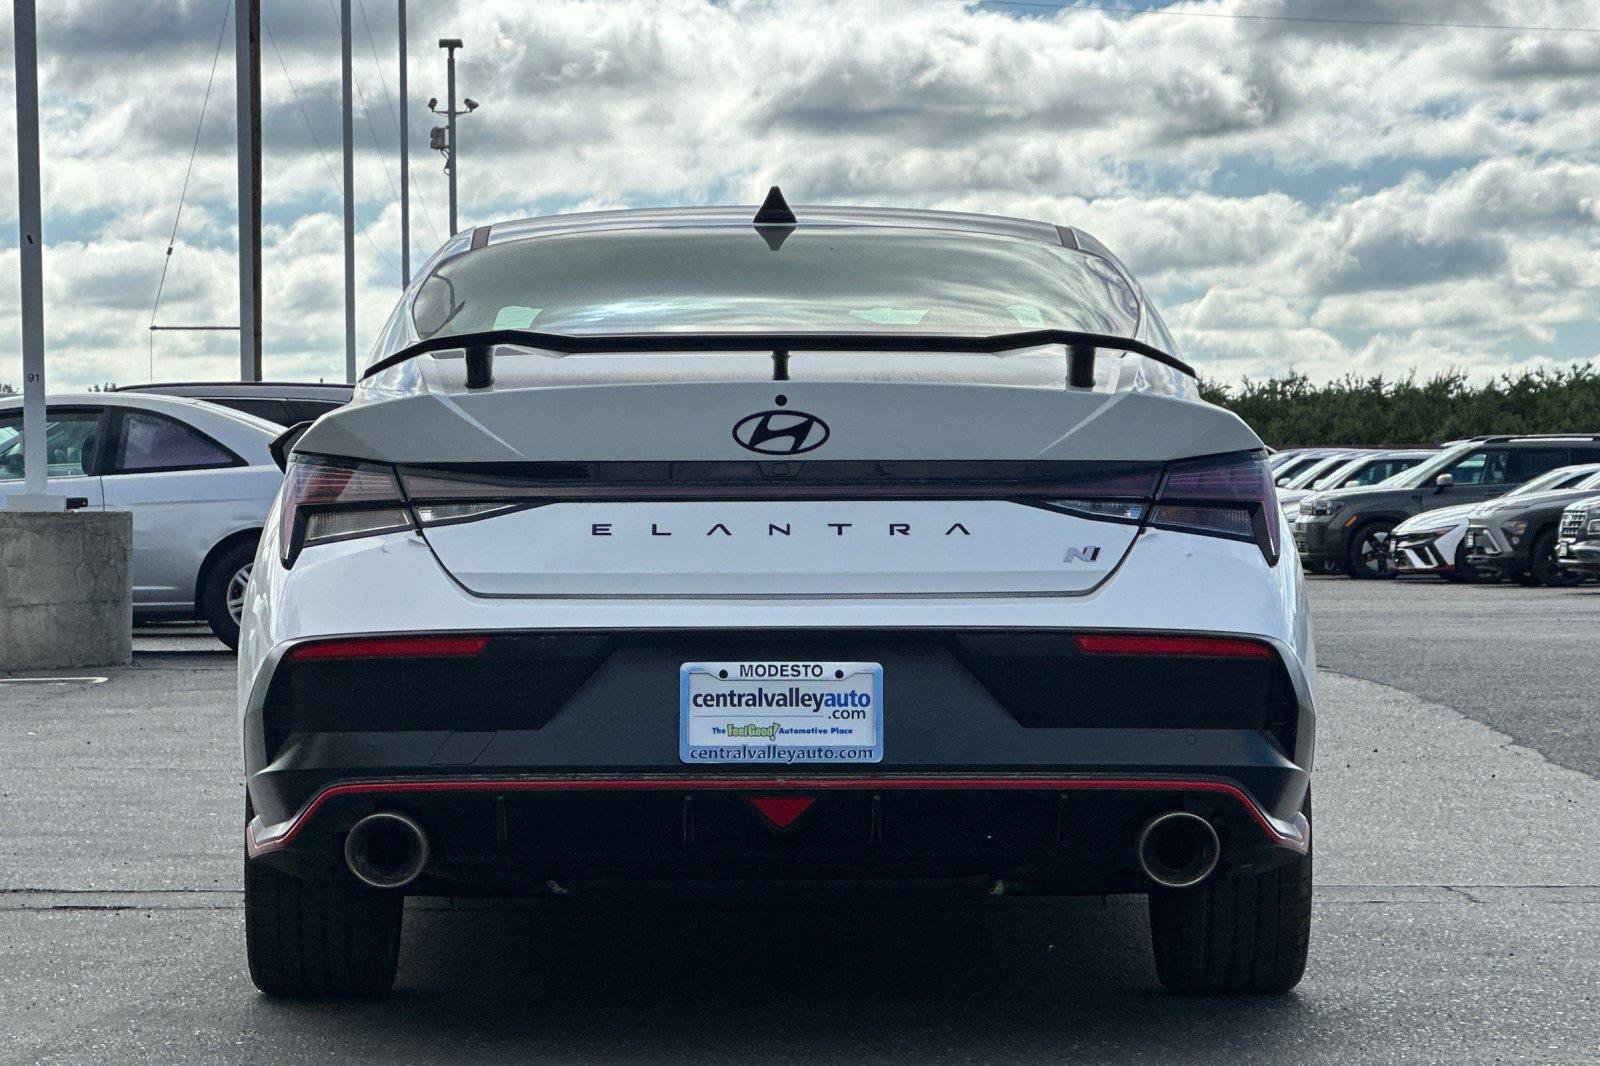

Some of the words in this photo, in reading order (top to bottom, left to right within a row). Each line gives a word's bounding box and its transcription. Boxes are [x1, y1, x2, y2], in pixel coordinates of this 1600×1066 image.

[27, 373, 39, 382] 91
[592, 523, 970, 536] ELANTRA
[739, 664, 823, 678] MODESTO
[692, 687, 871, 712] centralvalleyauto
[827, 708, 866, 720] .com
[712, 727, 726, 735] The
[778, 727, 828, 735] Automotive
[830, 727, 853, 735] Place
[690, 744, 873, 764] centralvalleyauto.com
